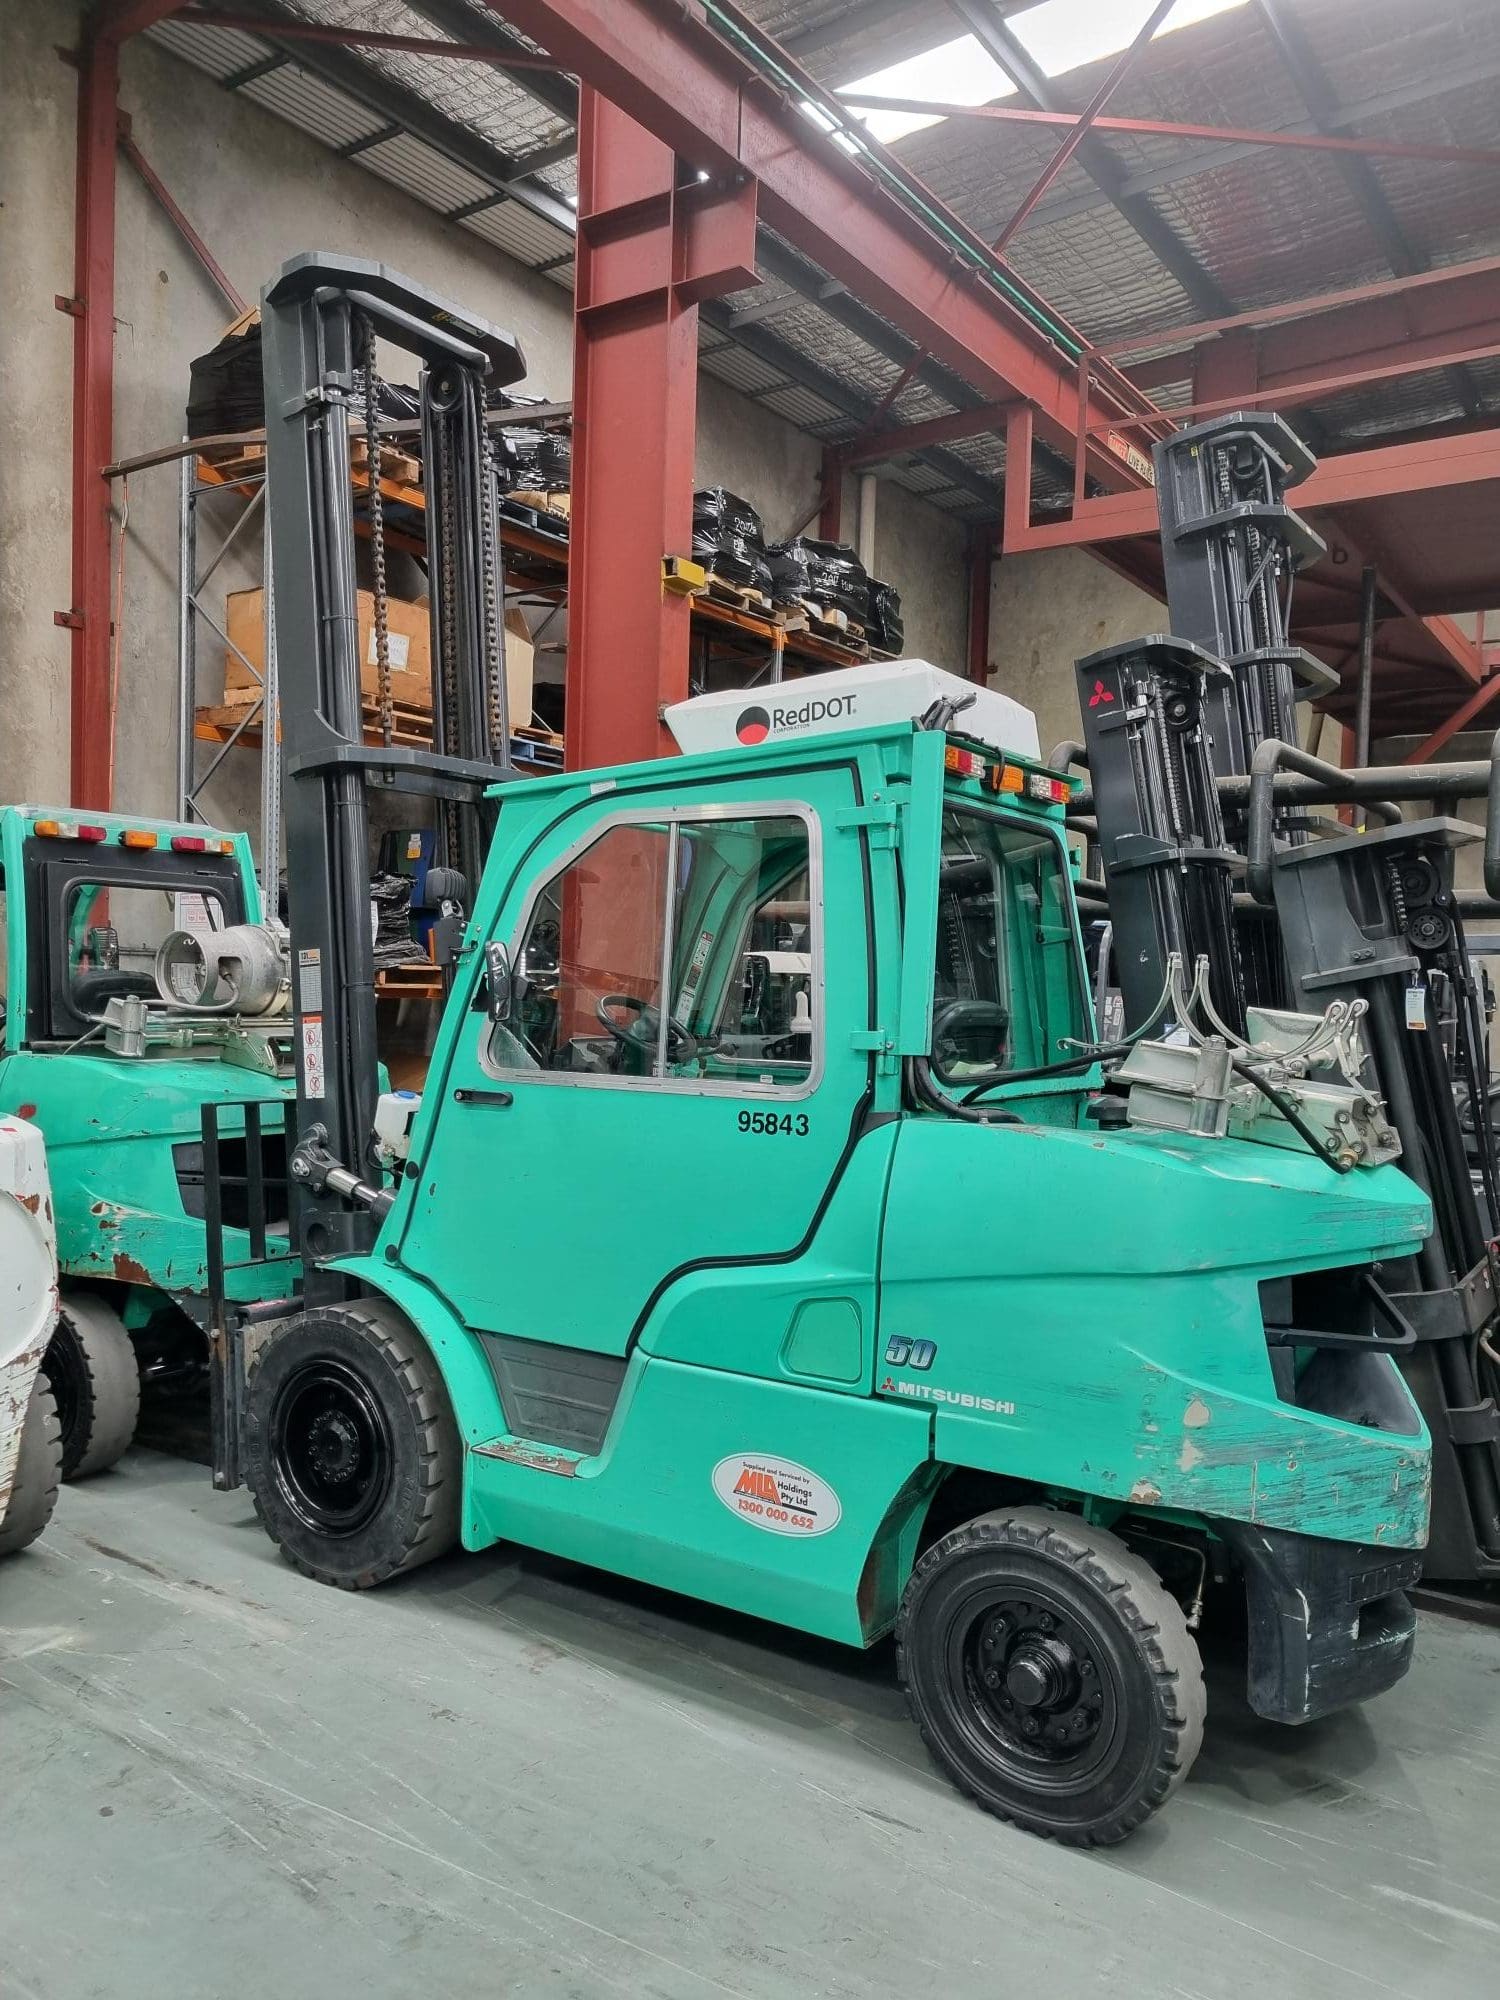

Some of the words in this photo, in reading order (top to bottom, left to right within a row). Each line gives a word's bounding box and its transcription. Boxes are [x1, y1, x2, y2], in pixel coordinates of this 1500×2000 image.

[773, 694, 856, 728] RedDOT
[773, 723, 810, 734] CORPORATION
[738, 1110, 809, 1136] 95843
[885, 1334, 938, 1371] 50
[898, 1381, 1015, 1415] MITSUBISHI
[743, 1461, 765, 1472] Supplied
[766, 1467, 778, 1476] and
[778, 1471, 801, 1482] Serviced
[802, 1476, 810, 1485] by
[777, 1480, 813, 1498] Holdings
[781, 1492, 795, 1504] Pty
[796, 1496, 808, 1507] Ltd
[739, 1499, 763, 1514] 1300
[766, 1507, 788, 1522] 000
[791, 1514, 814, 1529] 652
